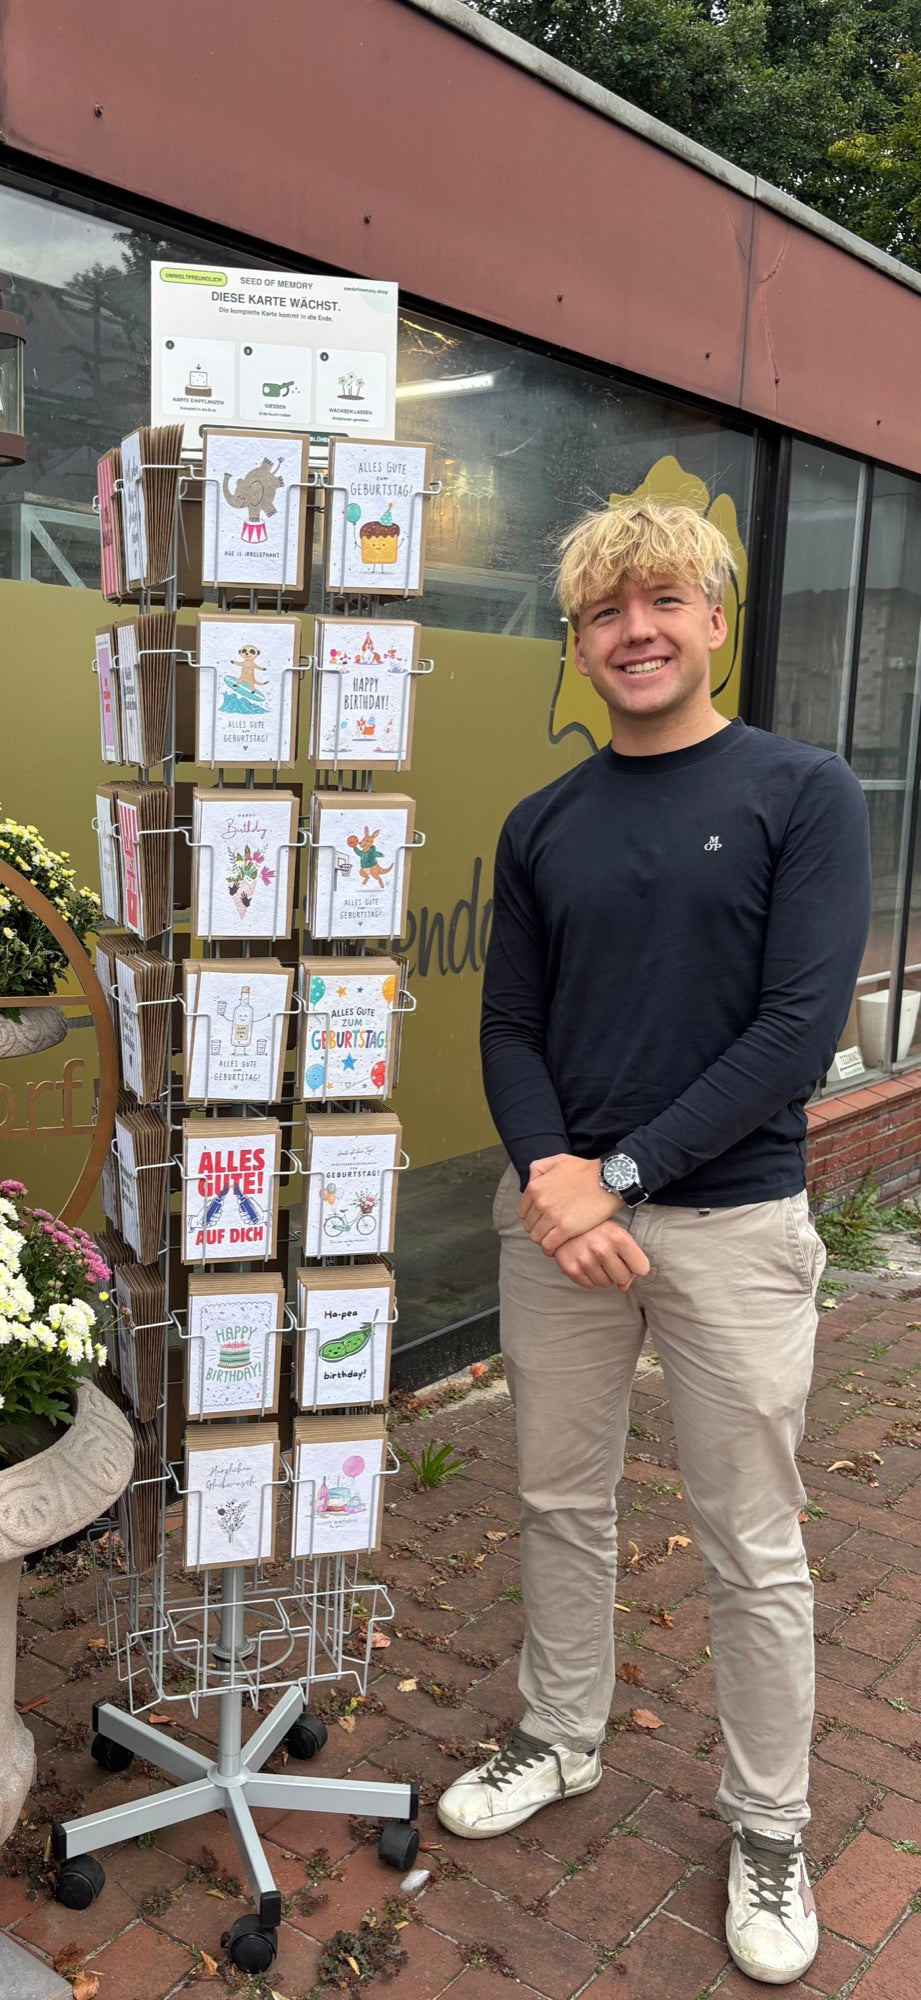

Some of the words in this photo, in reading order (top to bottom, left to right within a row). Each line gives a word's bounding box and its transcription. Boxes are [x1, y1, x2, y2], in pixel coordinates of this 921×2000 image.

[165, 273, 222, 282] UMWELTFREUNDLICH
[240, 277, 262, 286] SEED
[278, 280, 313, 290] MEMORY
[212, 292, 246, 303] DIESE
[248, 294, 286, 306] KARTE
[290, 296, 341, 312] WÄCHST.
[230, 308, 260, 317] komplette
[358, 462, 382, 473] ALLES
[386, 462, 406, 474] GUTE
[350, 482, 413, 498] GEBURTSTAG!
[353, 677, 378, 692] HAPPY
[344, 694, 388, 710] BIRTHDAY!
[228, 720, 246, 728] ALLES
[250, 720, 264, 729] GUTE
[224, 734, 268, 742] GEBURTSTAG!
[340, 911, 382, 919] GEBURTSTAG!
[331, 1008, 354, 1018] ALLES
[356, 1006, 376, 1017] GUTE
[342, 1018, 362, 1027] ZUM
[311, 1030, 388, 1050] GEBURTSTAG!
[214, 1073, 261, 1081] GEBURTSTAG!
[198, 1148, 265, 1174] ALLES
[326, 1170, 380, 1178] GEBURTSTAG!
[198, 1172, 264, 1198] GUTE!
[196, 1228, 225, 1246] AUF
[230, 1226, 263, 1244] DICH
[324, 1310, 358, 1319] Ha-pea
[216, 1326, 258, 1342] HAPPY
[206, 1364, 262, 1382] BIRTHDAY!
[324, 1369, 367, 1380] birthday!
